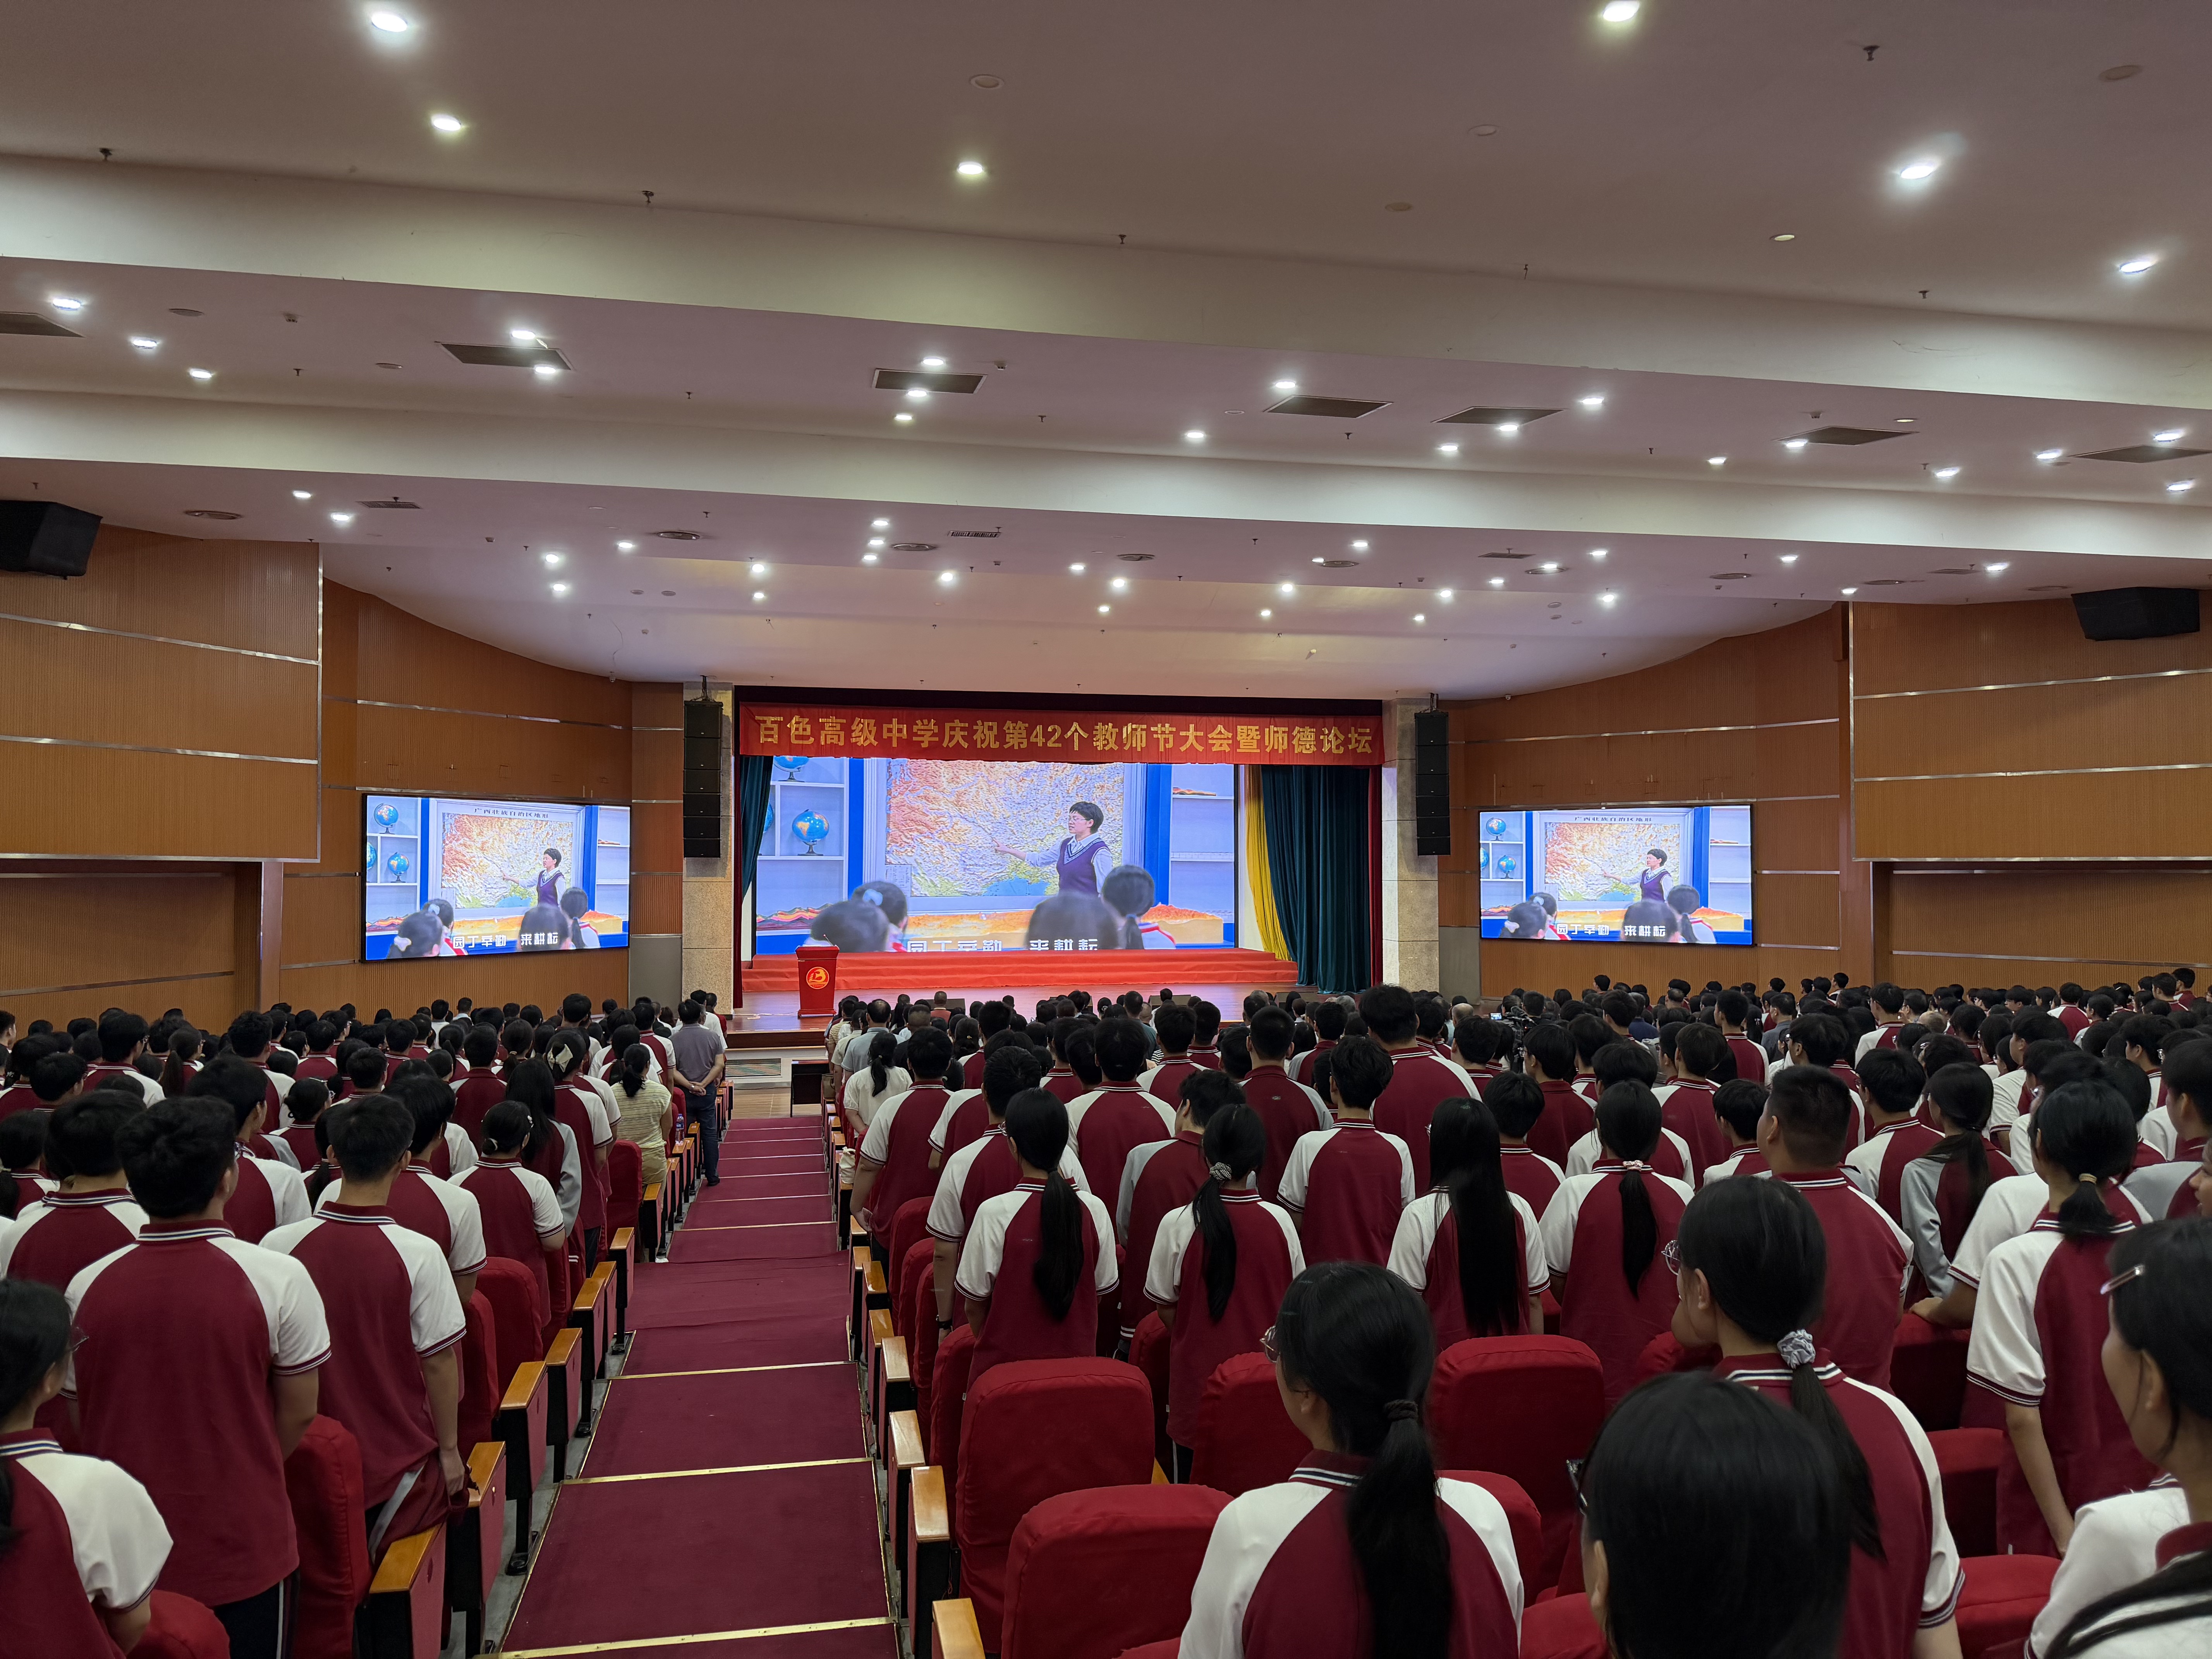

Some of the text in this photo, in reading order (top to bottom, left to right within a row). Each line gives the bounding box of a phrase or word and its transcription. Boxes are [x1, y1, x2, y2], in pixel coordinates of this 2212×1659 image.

[757, 716, 1372, 754] 百色高级中学庆祝第42个教师节大会暨师德论坛
[453, 932, 558, 949] 园丁辛勤 来耕耘
